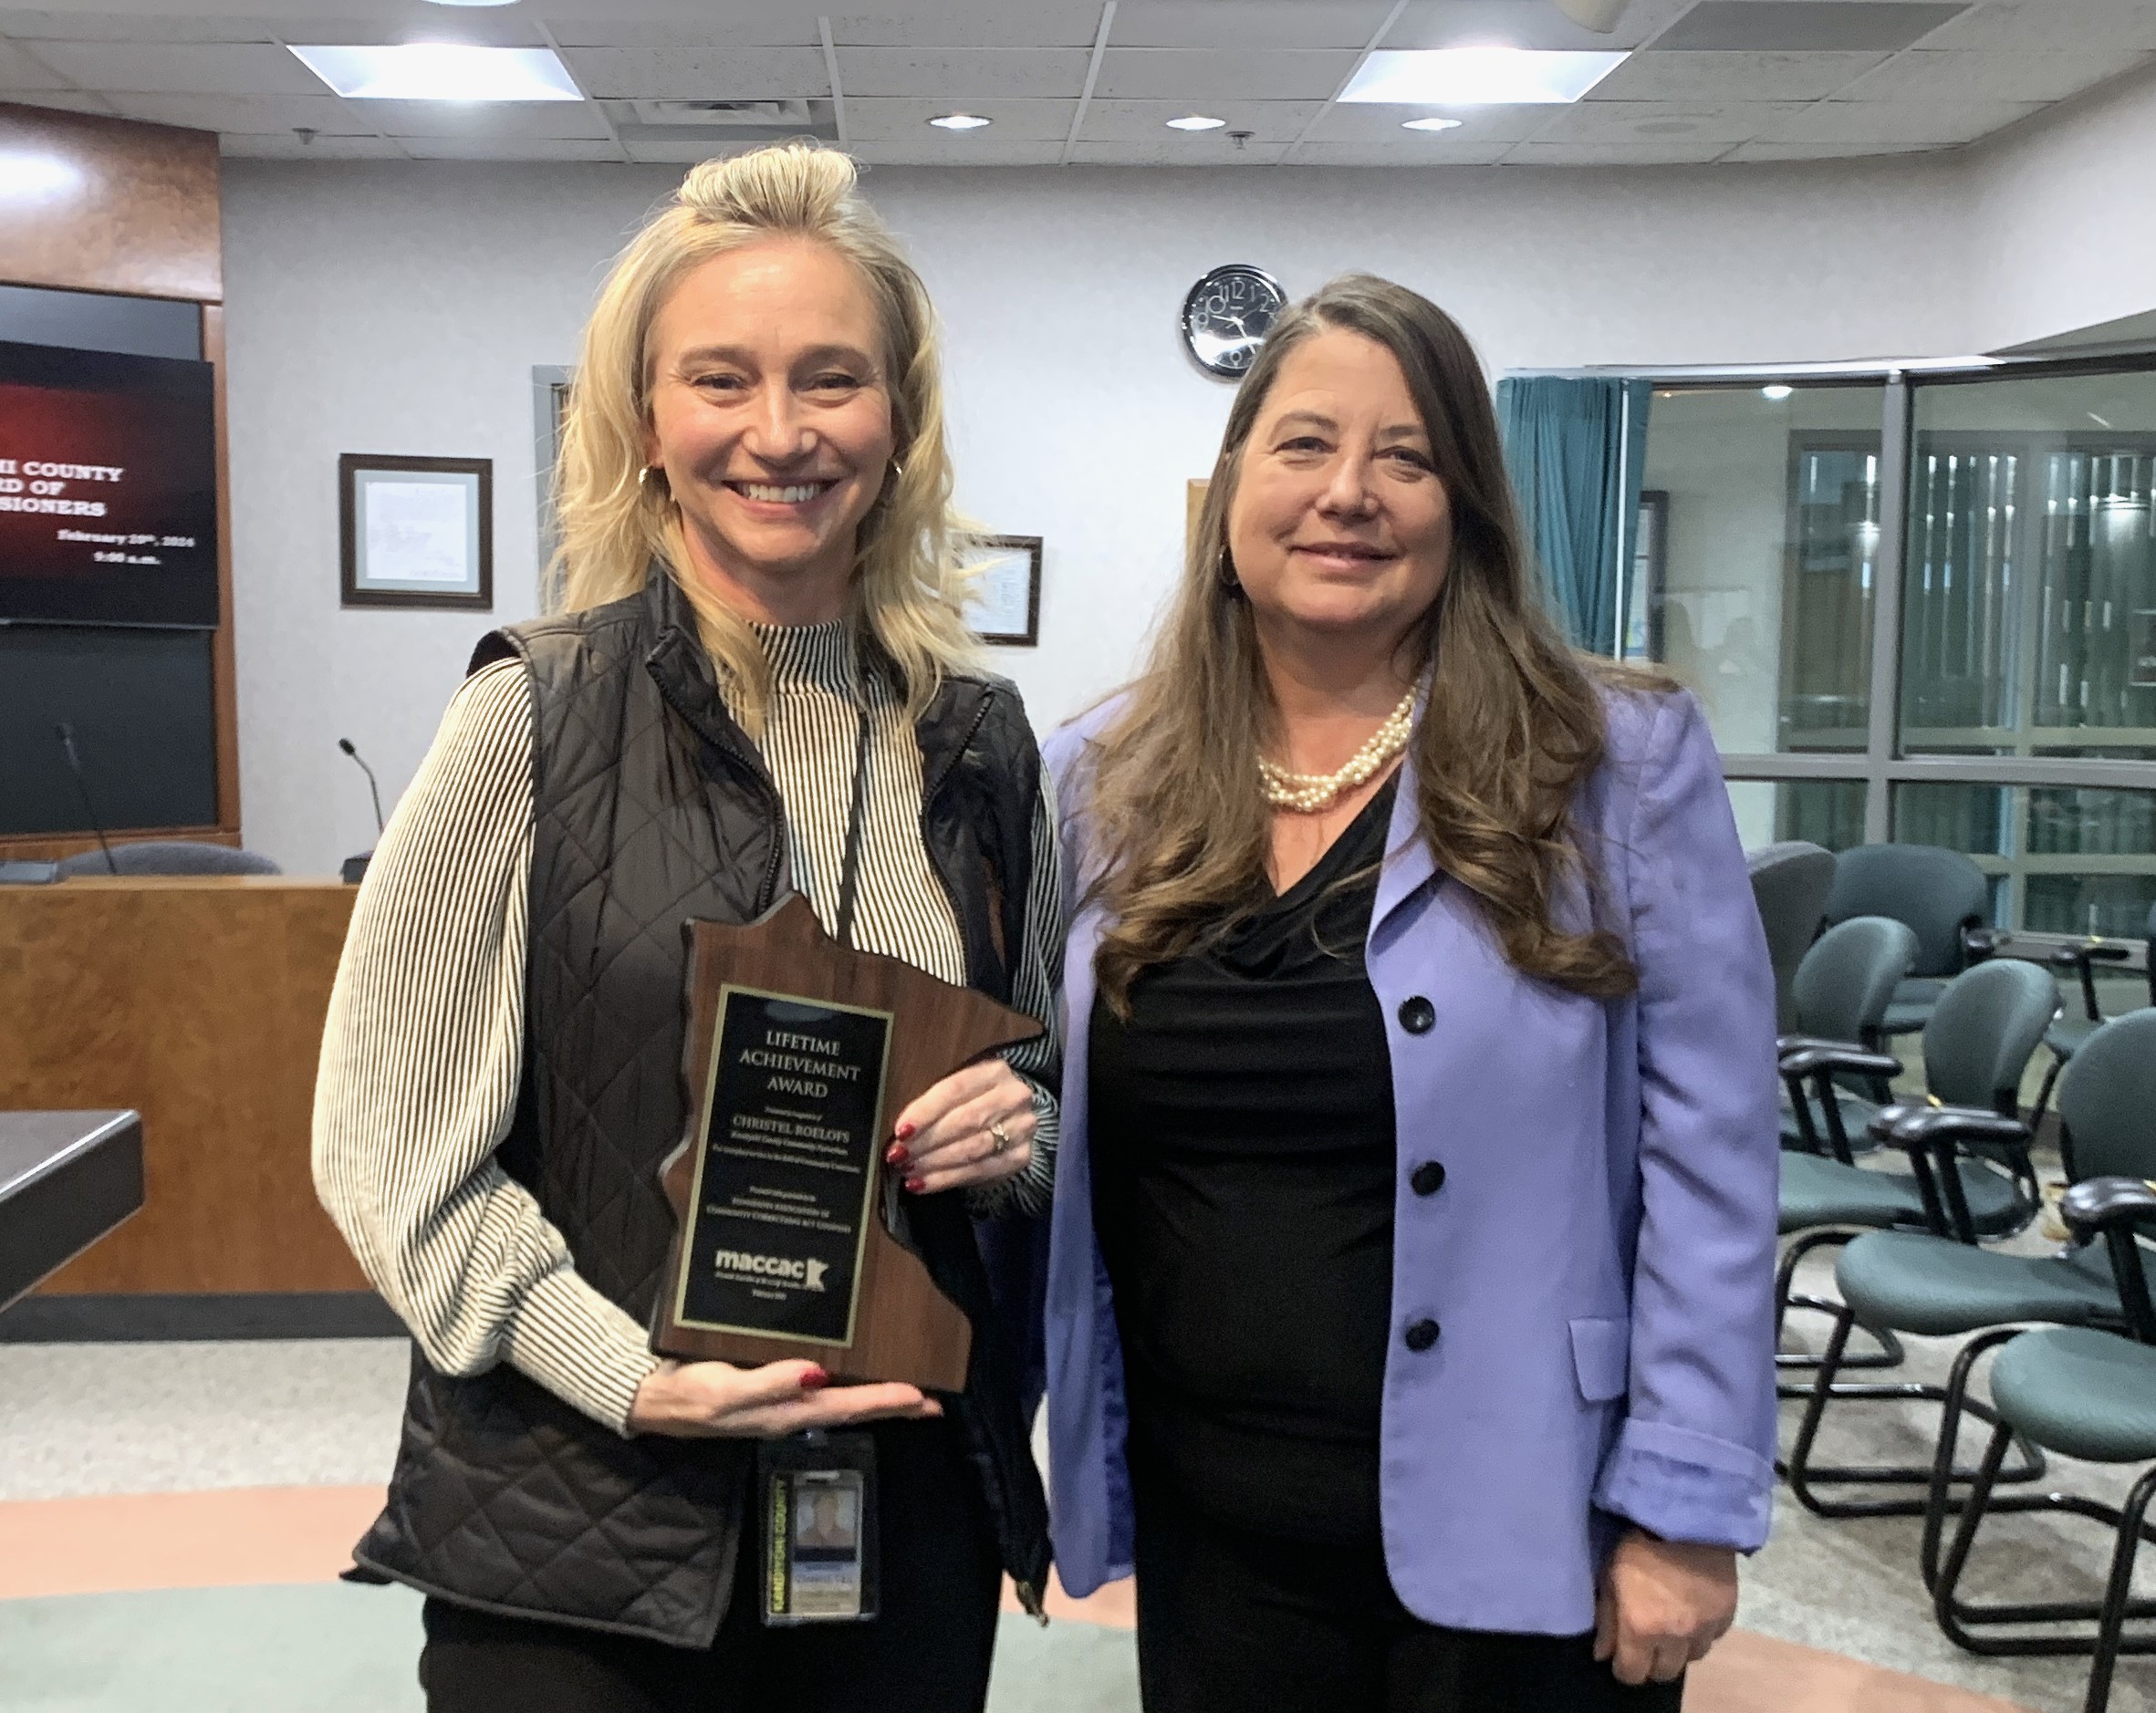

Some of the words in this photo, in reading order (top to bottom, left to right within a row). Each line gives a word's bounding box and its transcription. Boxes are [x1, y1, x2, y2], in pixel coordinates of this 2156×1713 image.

[1219, 285, 1229, 303] 11
[1231, 280, 1245, 299] 12
[1249, 285, 1255, 303] 1
[1259, 293, 1270, 313] 2
[23, 461, 125, 482] COUNTY
[29, 480, 66, 495] OF
[57, 528, 127, 545] February
[766, 1029, 841, 1057] LIFETIME
[739, 1049, 861, 1082] ACHIEVEMENT
[766, 1076, 828, 1098] AWARD
[715, 1250, 806, 1280] maccac
